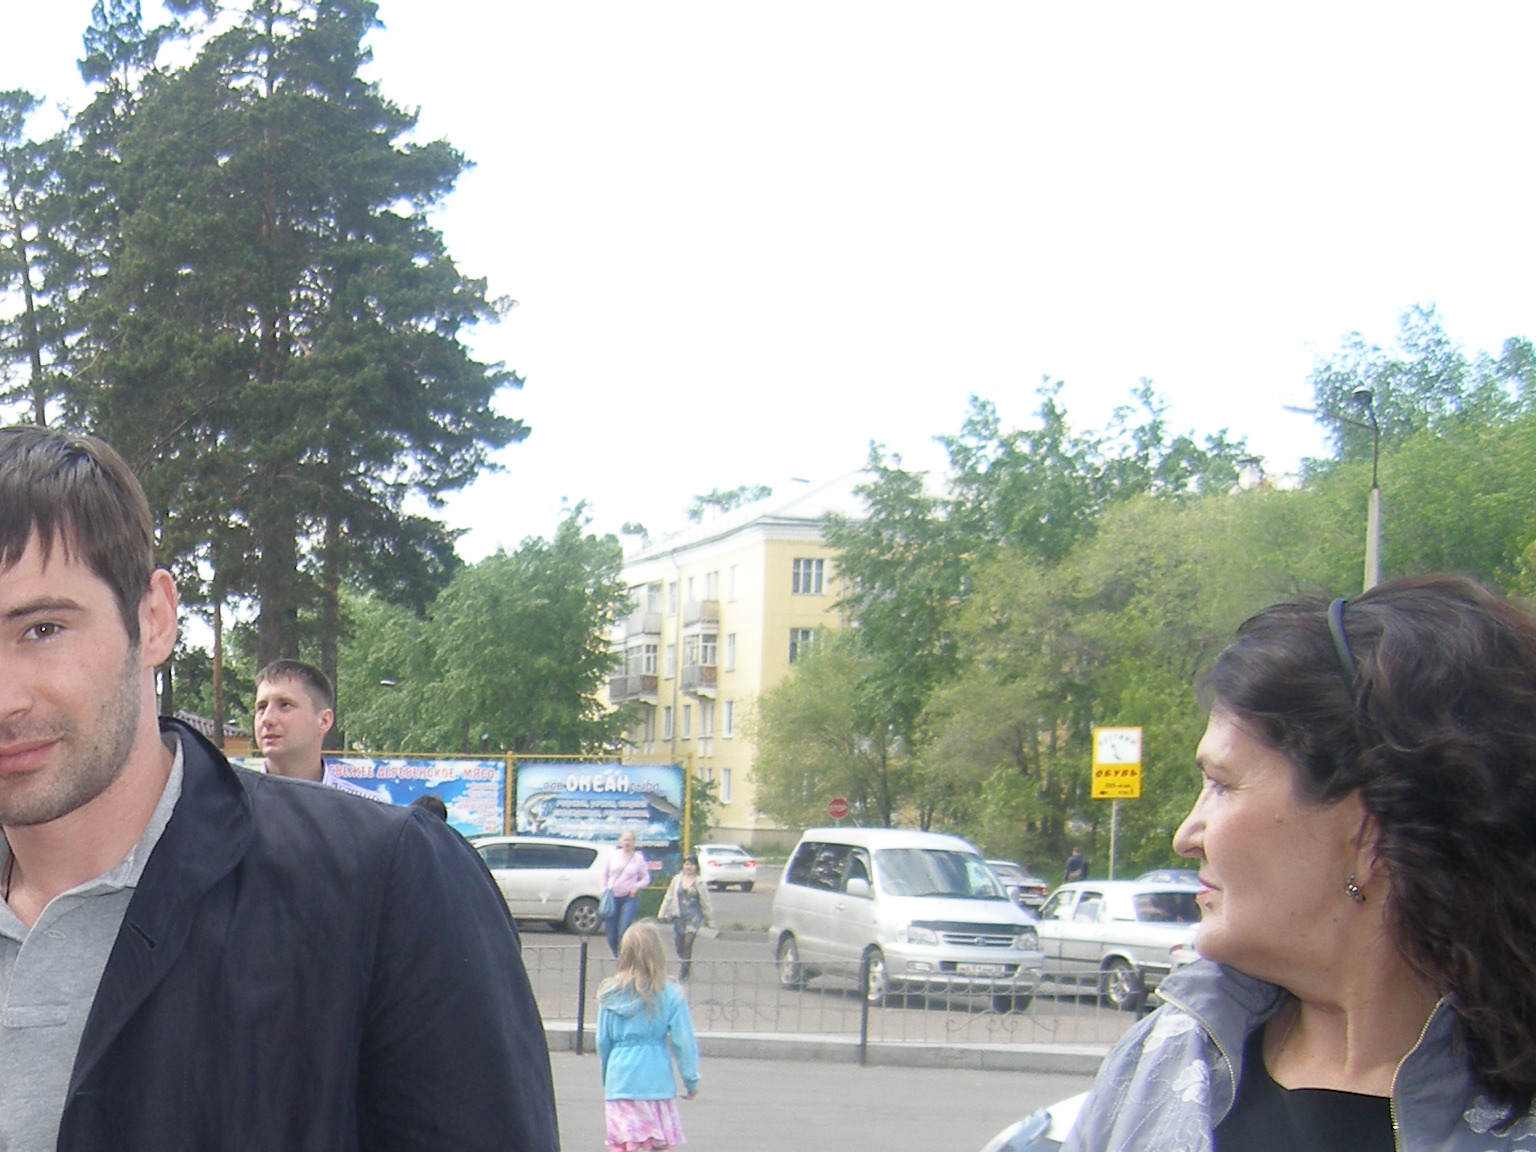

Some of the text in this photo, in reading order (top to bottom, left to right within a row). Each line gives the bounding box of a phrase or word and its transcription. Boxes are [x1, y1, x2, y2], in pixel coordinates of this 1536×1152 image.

[328, 764, 375, 779] СВЕЖЕЕ
[376, 766, 456, 780] ДЕРЕВЕНСКОЕ
[1095, 769, 1138, 778] ОБУВЬ
[565, 773, 630, 793] ОКЕАН
